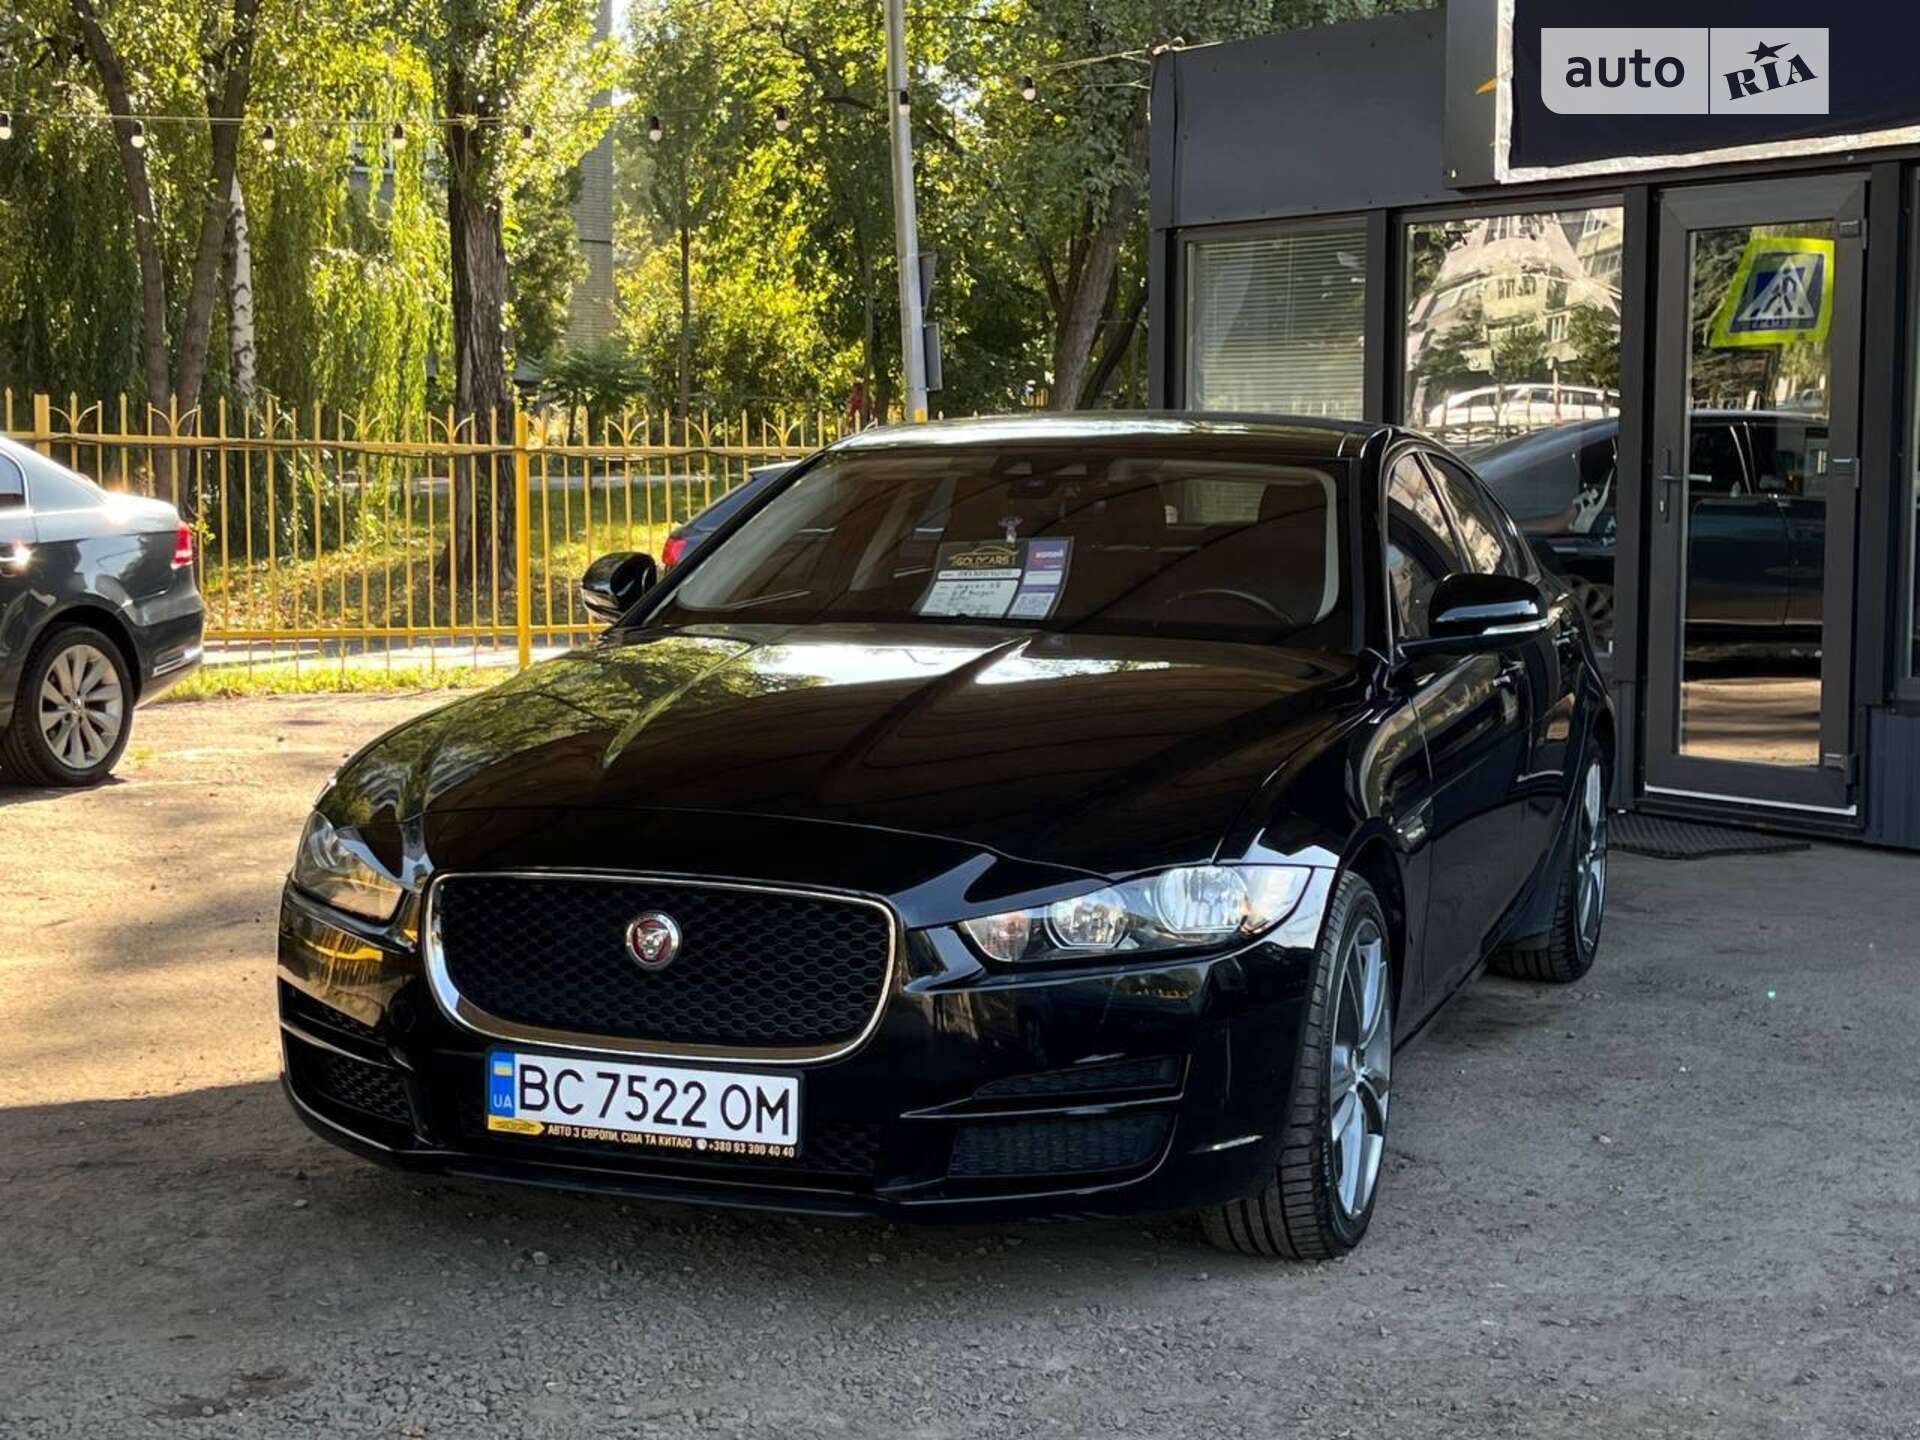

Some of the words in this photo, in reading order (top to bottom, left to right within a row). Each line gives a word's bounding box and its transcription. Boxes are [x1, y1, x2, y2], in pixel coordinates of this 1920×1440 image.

[492, 1093, 513, 1110] UA
[518, 1063, 585, 1116] BC
[595, 1071, 708, 1129] 7522
[719, 1083, 791, 1136] OM
[547, 1124, 572, 1137] АВТО
[645, 1133, 657, 1145] ТА
[658, 1135, 693, 1149] КИТАЮ
[708, 1141, 732, 1152] +380
[768, 1145, 781, 1157] 40
[782, 1146, 795, 1158] 40
